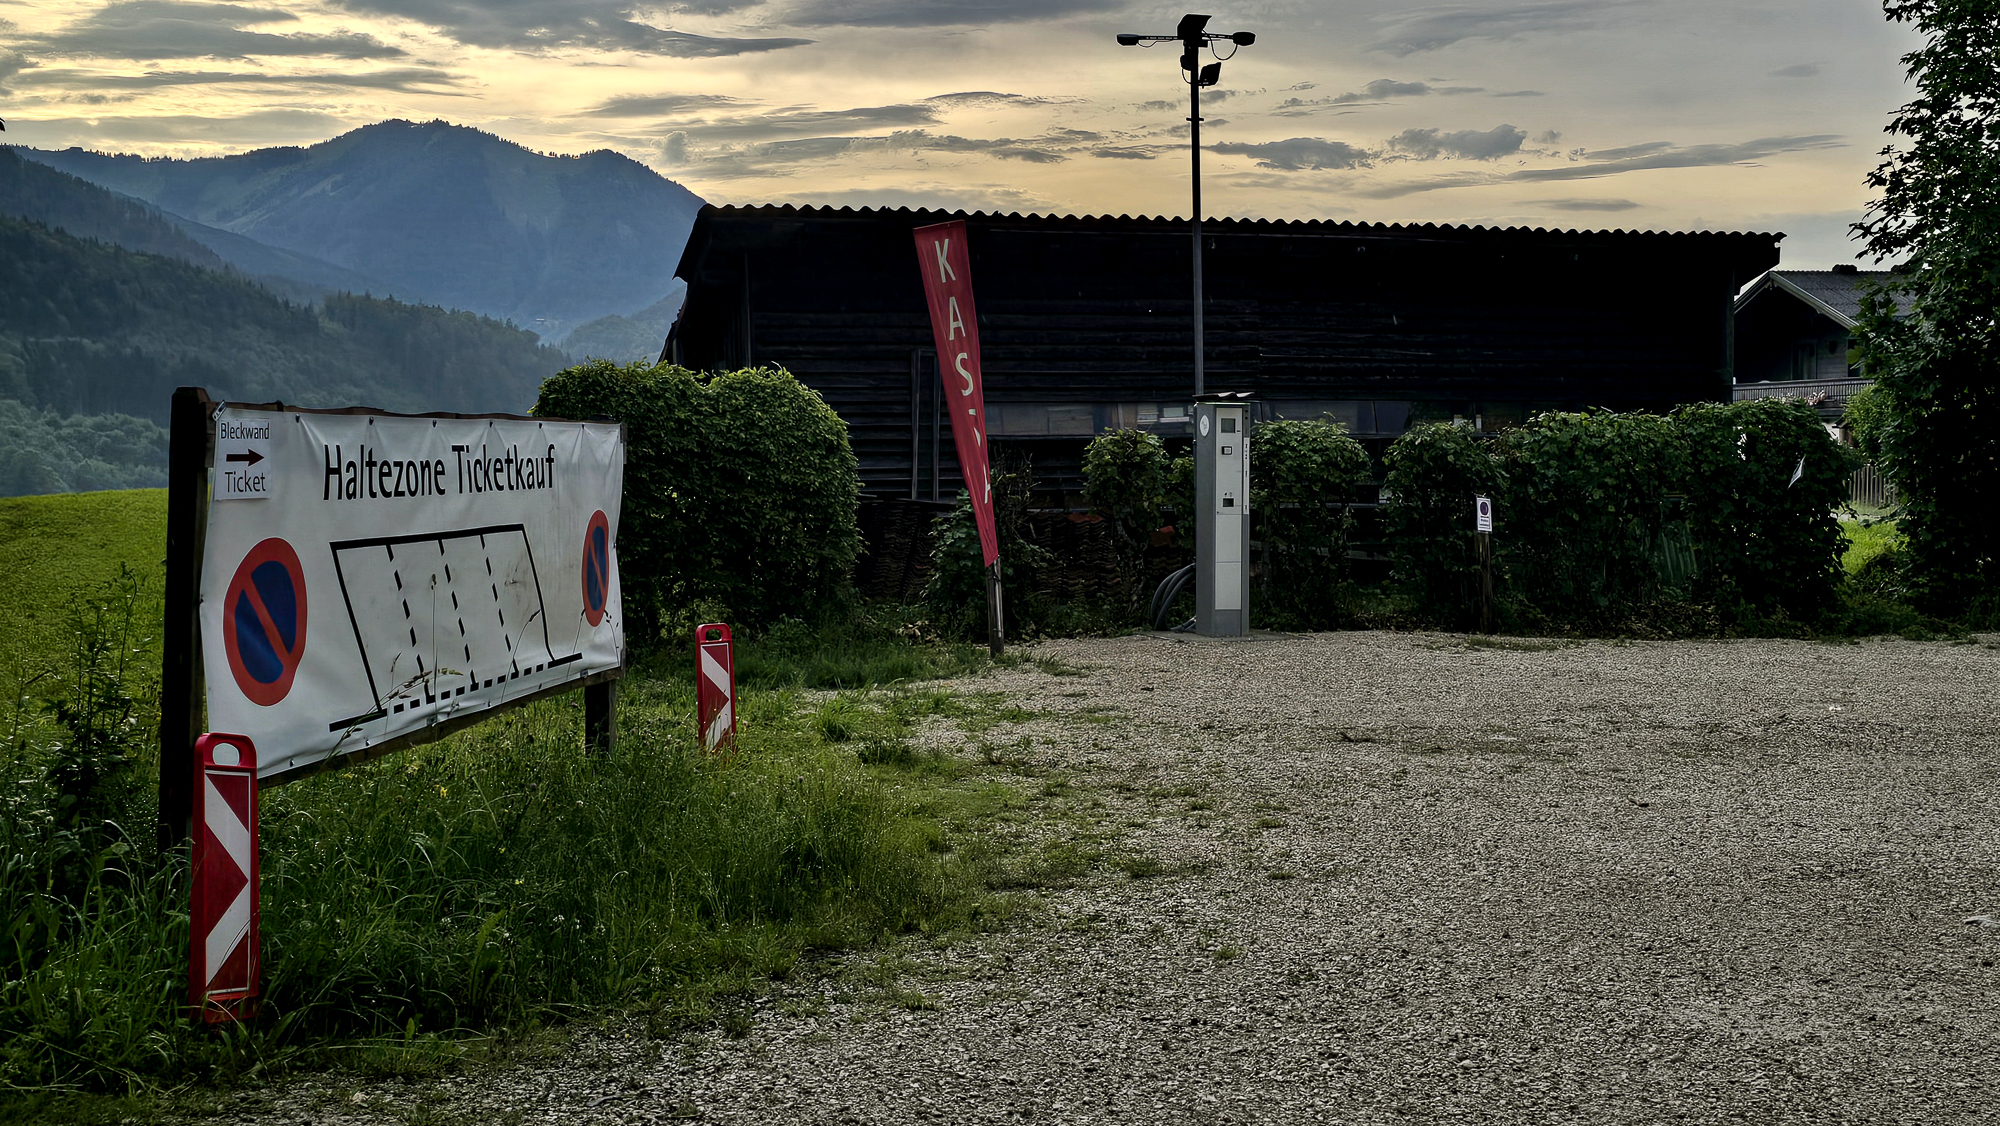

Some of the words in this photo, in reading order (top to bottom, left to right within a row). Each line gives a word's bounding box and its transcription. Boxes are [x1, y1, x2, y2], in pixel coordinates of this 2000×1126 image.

[220, 421, 270, 440] Bleckwand
[224, 469, 266, 493] Ticket
[323, 443, 446, 501] Haltezone
[451, 443, 555, 494] Ticketkauf
